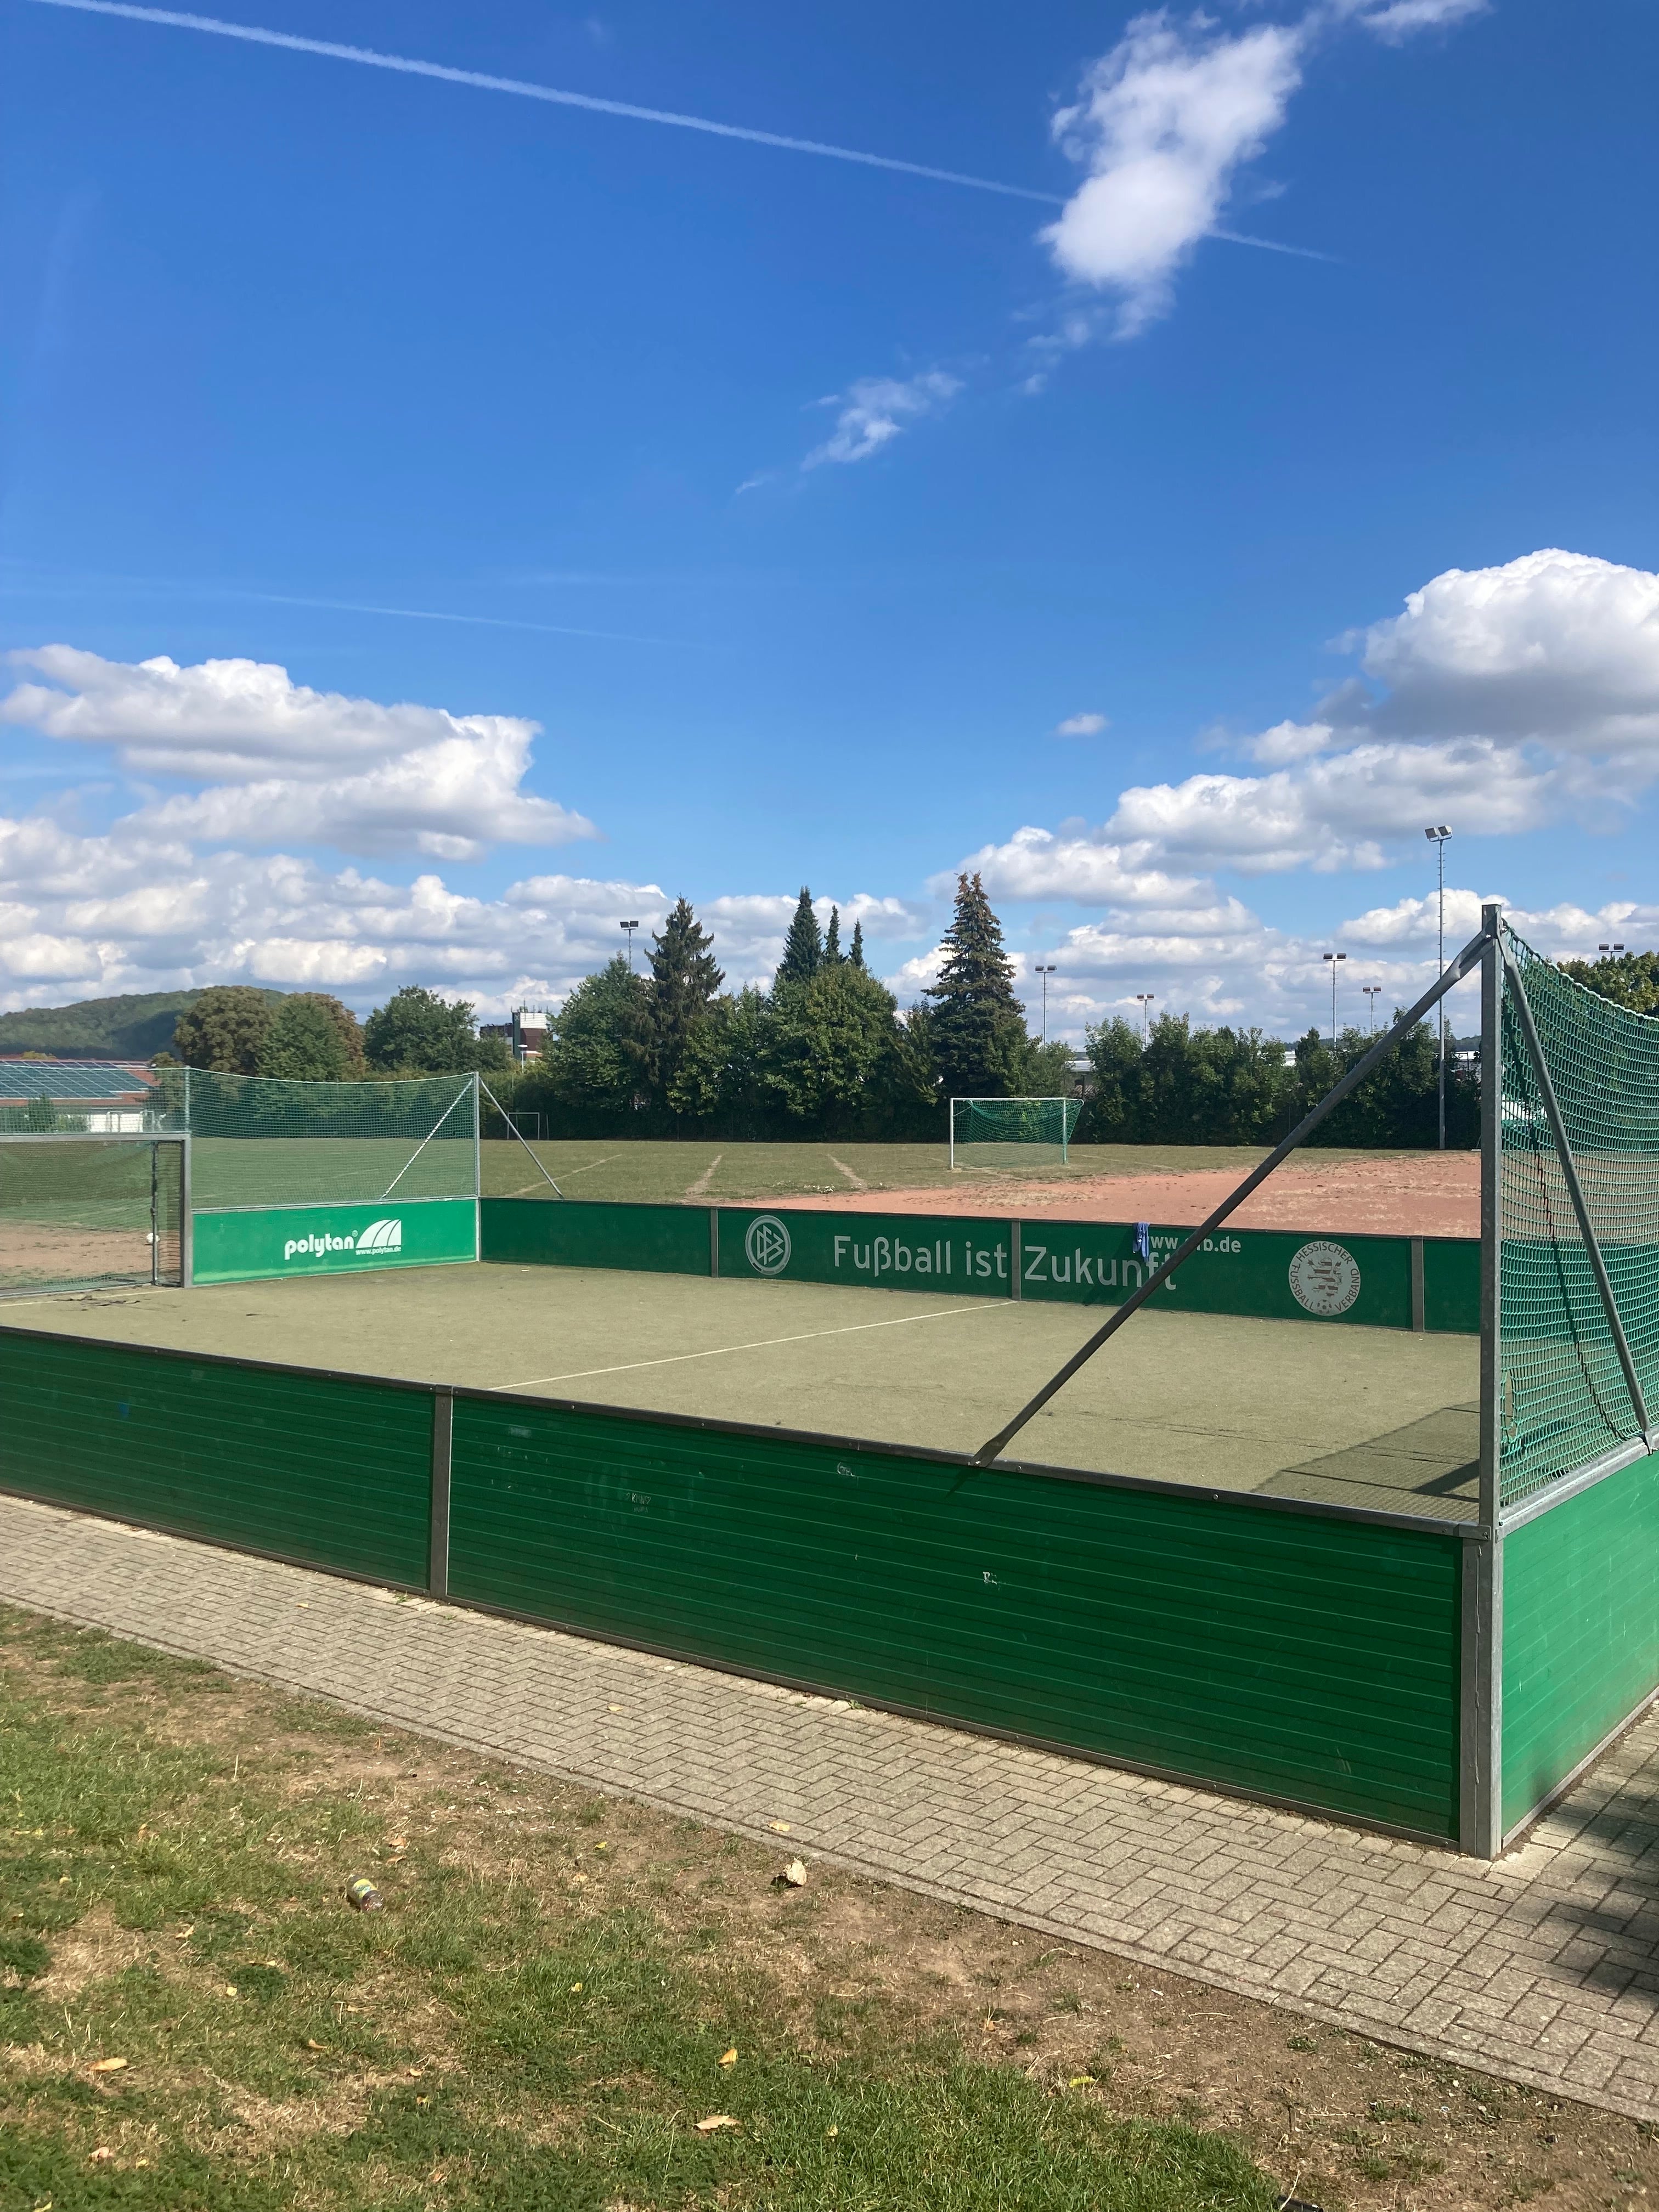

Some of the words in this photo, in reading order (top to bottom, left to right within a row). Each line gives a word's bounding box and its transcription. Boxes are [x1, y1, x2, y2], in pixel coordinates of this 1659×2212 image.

[355, 1245, 402, 1255] www.polytan.de
[834, 1235, 951, 1278] Fußball
[966, 1241, 1007, 1279] ist
[1295, 1242, 1353, 1265] HESSISCHER
[1290, 1263, 1314, 1311] FUSSBALL
[1334, 1268, 1359, 1312] VERBAND
